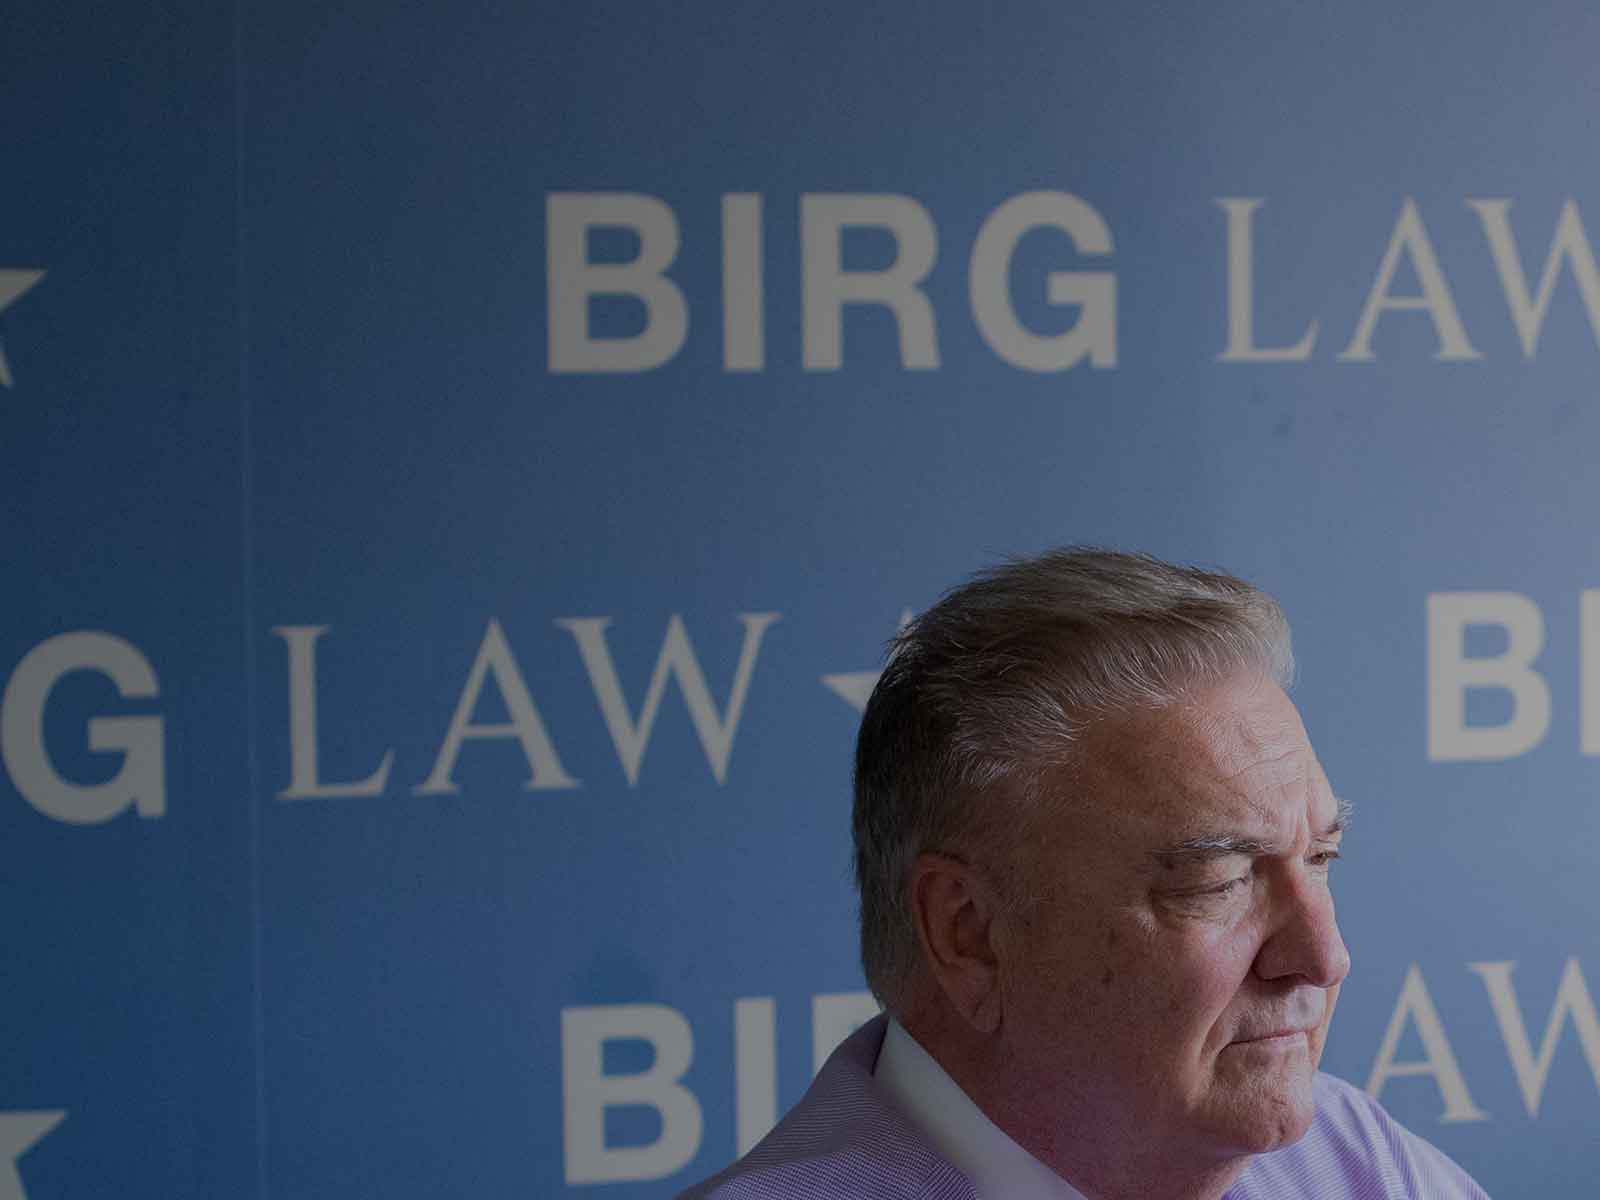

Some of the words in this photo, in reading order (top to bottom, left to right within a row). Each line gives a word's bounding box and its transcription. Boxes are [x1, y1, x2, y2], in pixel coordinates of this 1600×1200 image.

[546, 191, 1118, 373] BIRG
[0, 631, 166, 825] G
[274, 611, 782, 799] LAW
